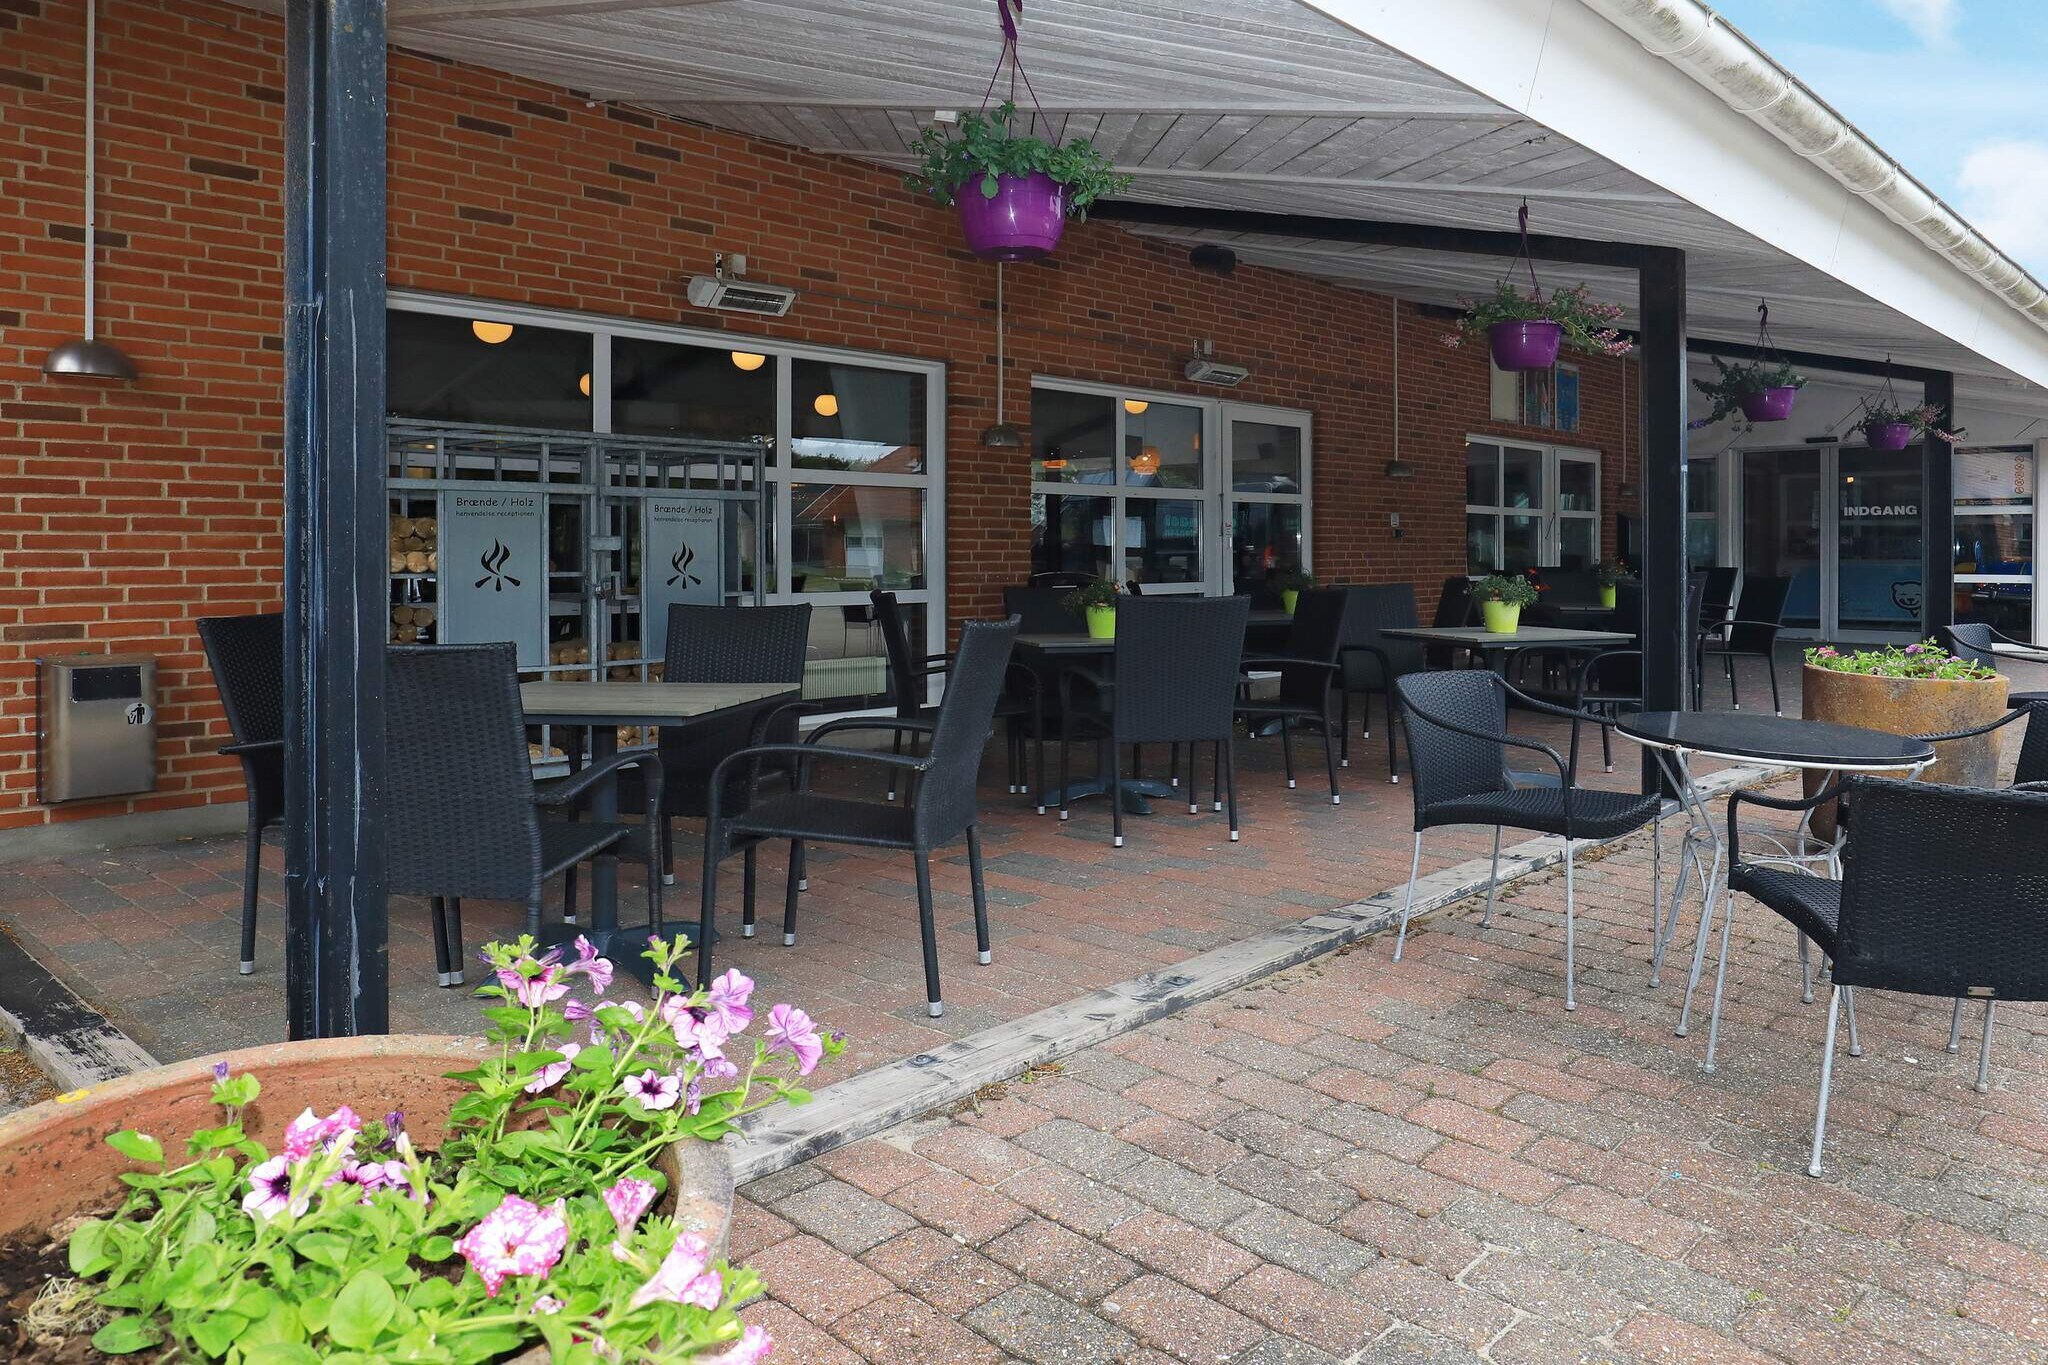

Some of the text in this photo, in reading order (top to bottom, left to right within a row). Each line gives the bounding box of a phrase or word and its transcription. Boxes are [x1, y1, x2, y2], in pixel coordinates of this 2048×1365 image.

[456, 497, 498, 506] Brænde
[510, 497, 534, 507] Holz
[654, 504, 686, 514] Brænde
[695, 505, 712, 514] Holz
[1843, 505, 1918, 516] INDGANG
